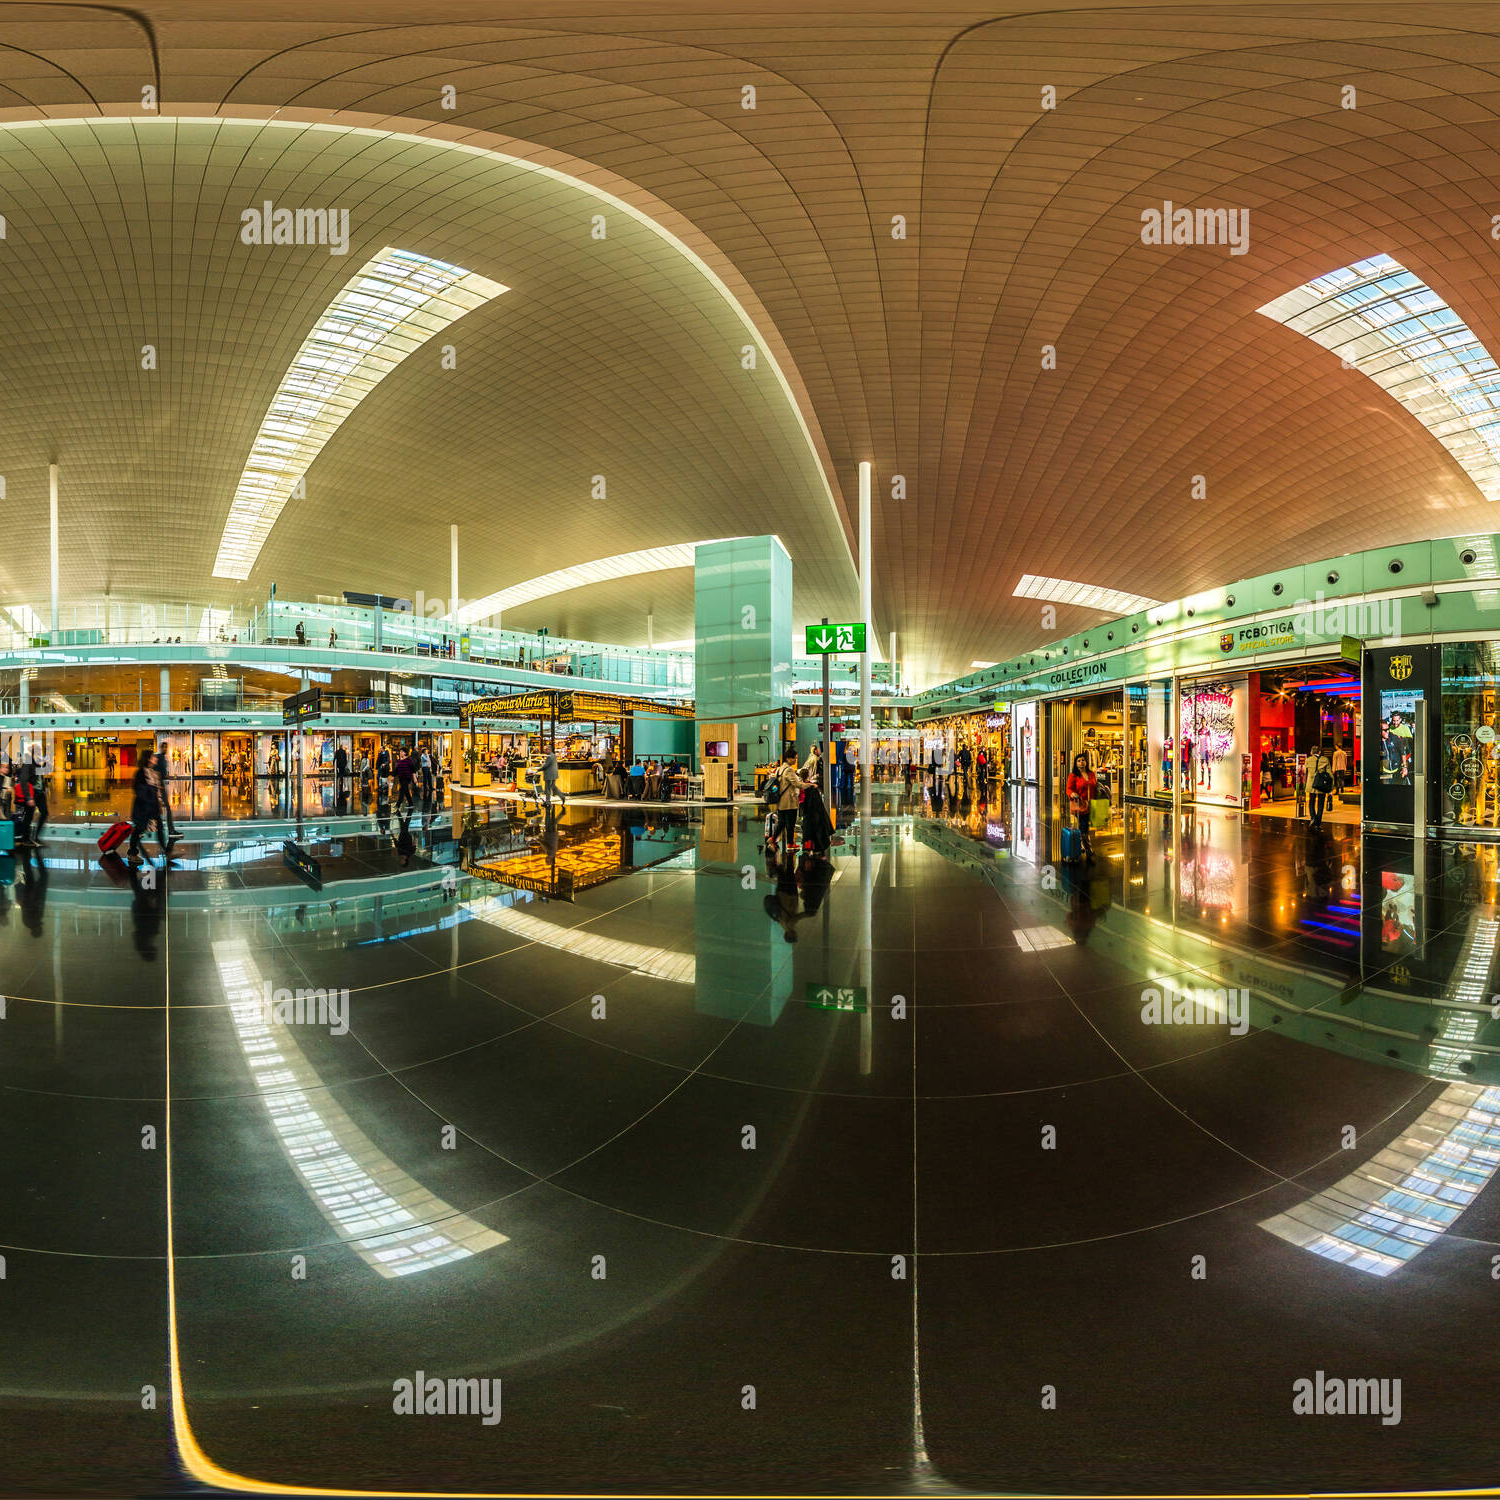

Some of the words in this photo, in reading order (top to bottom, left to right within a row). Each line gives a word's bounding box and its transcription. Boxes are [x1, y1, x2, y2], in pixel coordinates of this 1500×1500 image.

[1239, 621, 1294, 641] FCBOTIGA
[1270, 634, 1294, 647] STORE
[1050, 662, 1107, 684] COLLECTION
